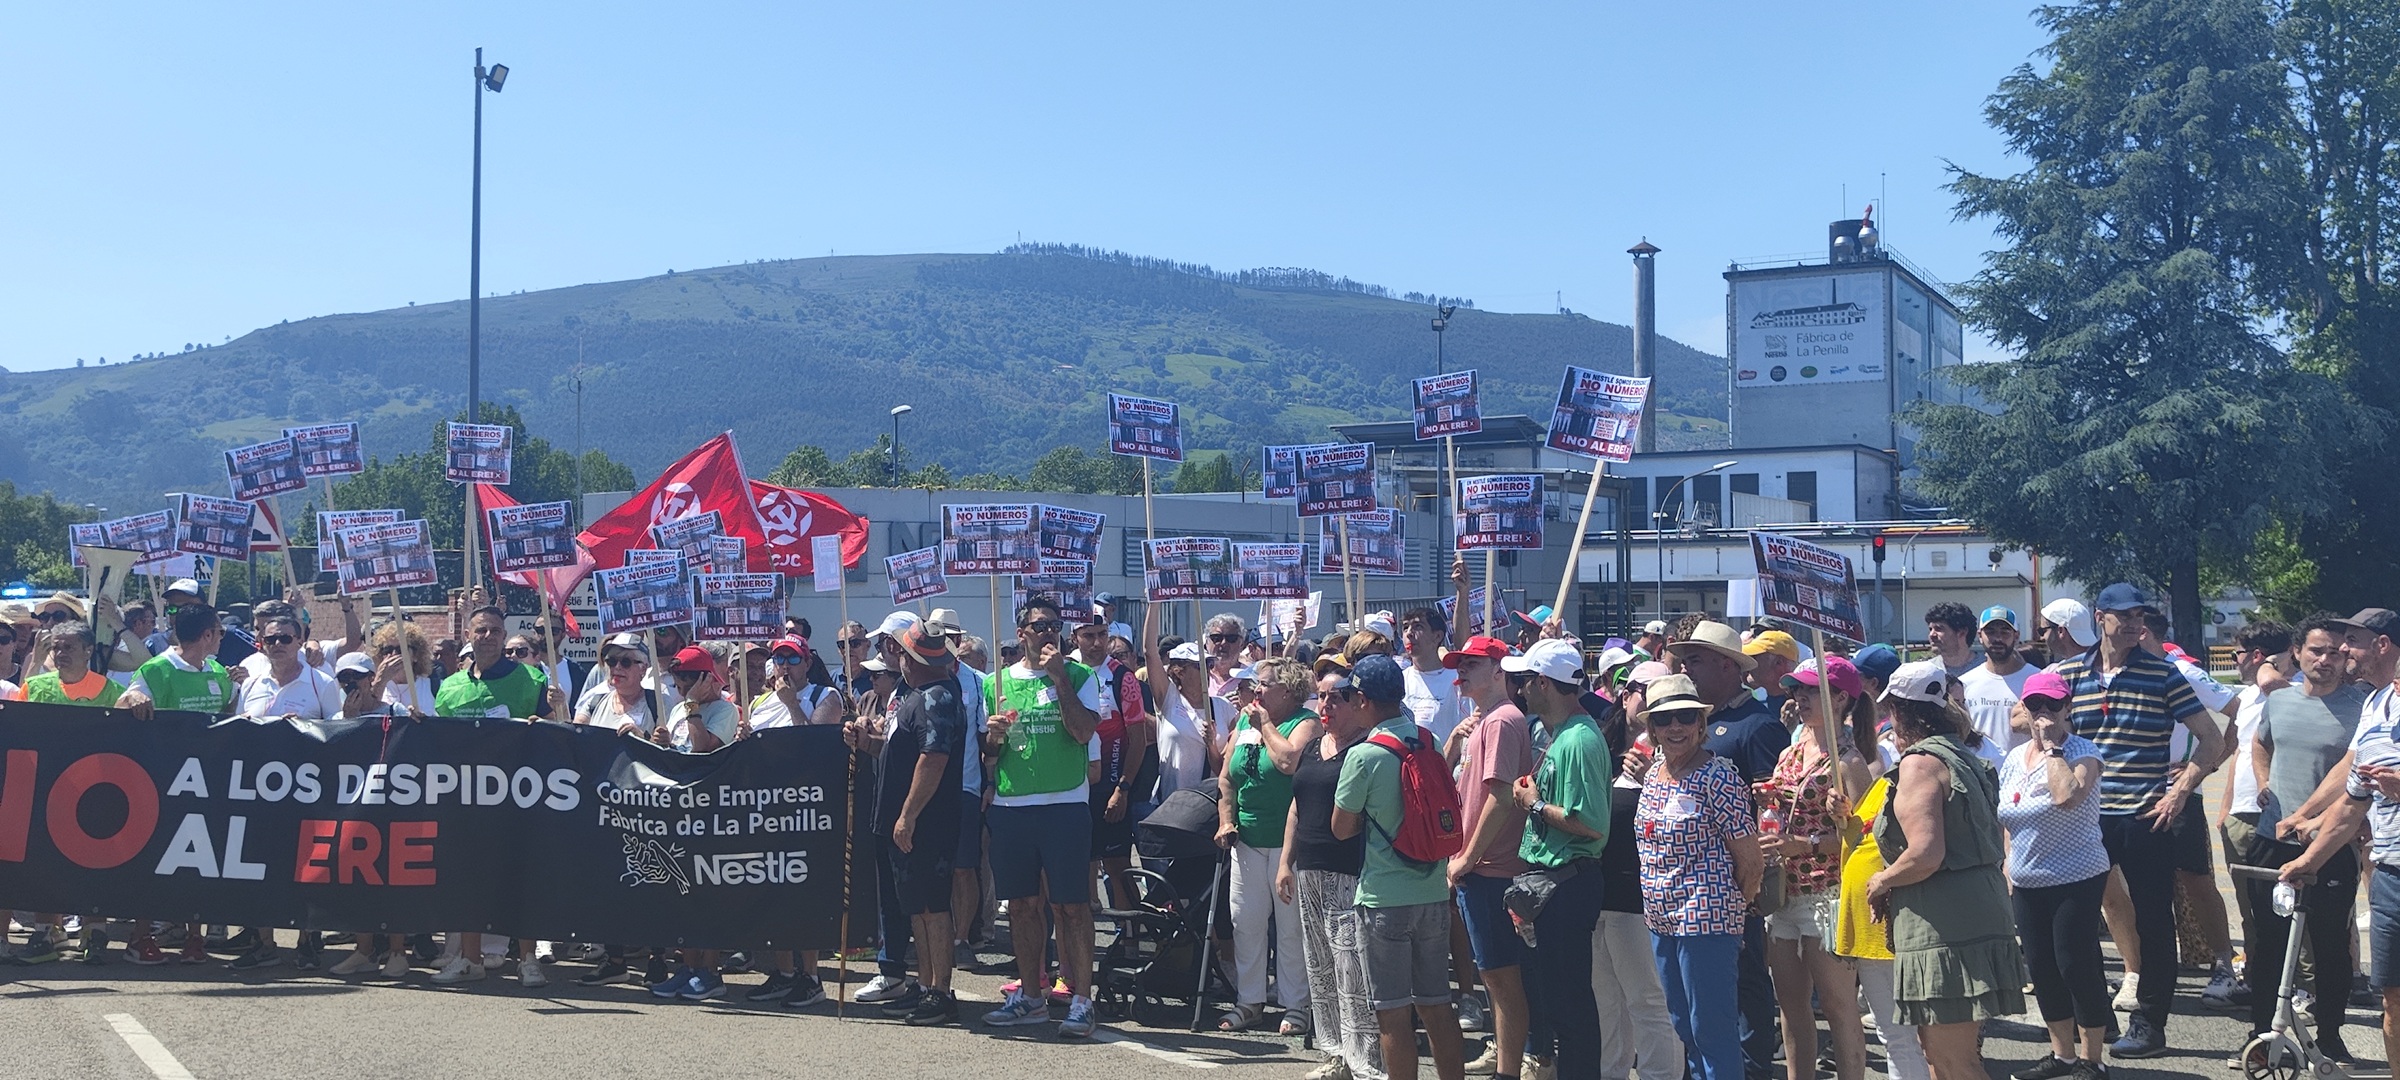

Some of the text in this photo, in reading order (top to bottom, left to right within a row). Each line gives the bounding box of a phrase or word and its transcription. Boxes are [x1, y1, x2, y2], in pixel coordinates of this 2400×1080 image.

[1796, 331, 1854, 344] Fábrica de
[1796, 345, 1848, 357] La Penilla
[1422, 377, 1469, 392] NO NÚMEROS
[1592, 374, 1614, 383] NESTLÉ
[1580, 379, 1645, 395] NO NÚMEROS
[1134, 403, 1171, 415] NÚMEROS
[1423, 421, 1468, 434] ¡NO AL ERE!
[1119, 441, 1169, 454] ¡NO AL ERE!
[1562, 434, 1626, 454] ¡NO AL ERE!
[237, 443, 291, 461] NO NÚMEROS
[1306, 451, 1365, 464] NO NÚMEROS
[242, 480, 294, 498] ¡NO AL ERE!
[1481, 482, 1530, 492] NÚMEROS
[194, 500, 248, 515] NO NÚMEROS
[1307, 499, 1362, 511] ¡NO AL ERE!
[349, 517, 394, 525] NÚMEROS
[502, 509, 563, 522] NO NÚMEROS
[957, 510, 1028, 521] NO NÚMEROS
[1060, 513, 1097, 524] NÚMEROS
[348, 527, 418, 543] NO NÚMEROS
[1463, 535, 1478, 544] ¡NO
[186, 542, 204, 550] ¡NO
[1175, 543, 1221, 552] NÚMEROS
[1054, 549, 1065, 557] AL
[1768, 543, 1843, 571] NO NÚMEROS
[506, 553, 563, 568] ¡NO AL ERE!
[652, 560, 676, 569] PERSONAS,
[771, 554, 801, 567] CJC
[954, 561, 976, 570] ¡NO
[980, 561, 993, 569] AL
[609, 565, 677, 584] NO NÚMEROS
[1044, 565, 1085, 574] NÚMEROS
[353, 572, 419, 588] ¡NO AL ERE!
[706, 579, 773, 589] NO NÚMEROS
[566, 596, 582, 606] stlé
[612, 611, 676, 628] ¡NO AL ERE!
[1775, 601, 1846, 630] ¡NO AL ERE!
[705, 627, 725, 635] ¡NO
[568, 637, 597, 645] carga
[1981, 697, 2000, 706] Never
[1026, 725, 1055, 734] Nestlé
[1110, 738, 1121, 782] CANTABRIA
[166, 757, 582, 812] A LOS DESPIDOS
[596, 782, 824, 811] Comité de Empresa
[598, 805, 832, 836] Fábrica de La Penilla
[154, 813, 438, 885] AL ERE
[694, 851, 808, 885] Nestlé
